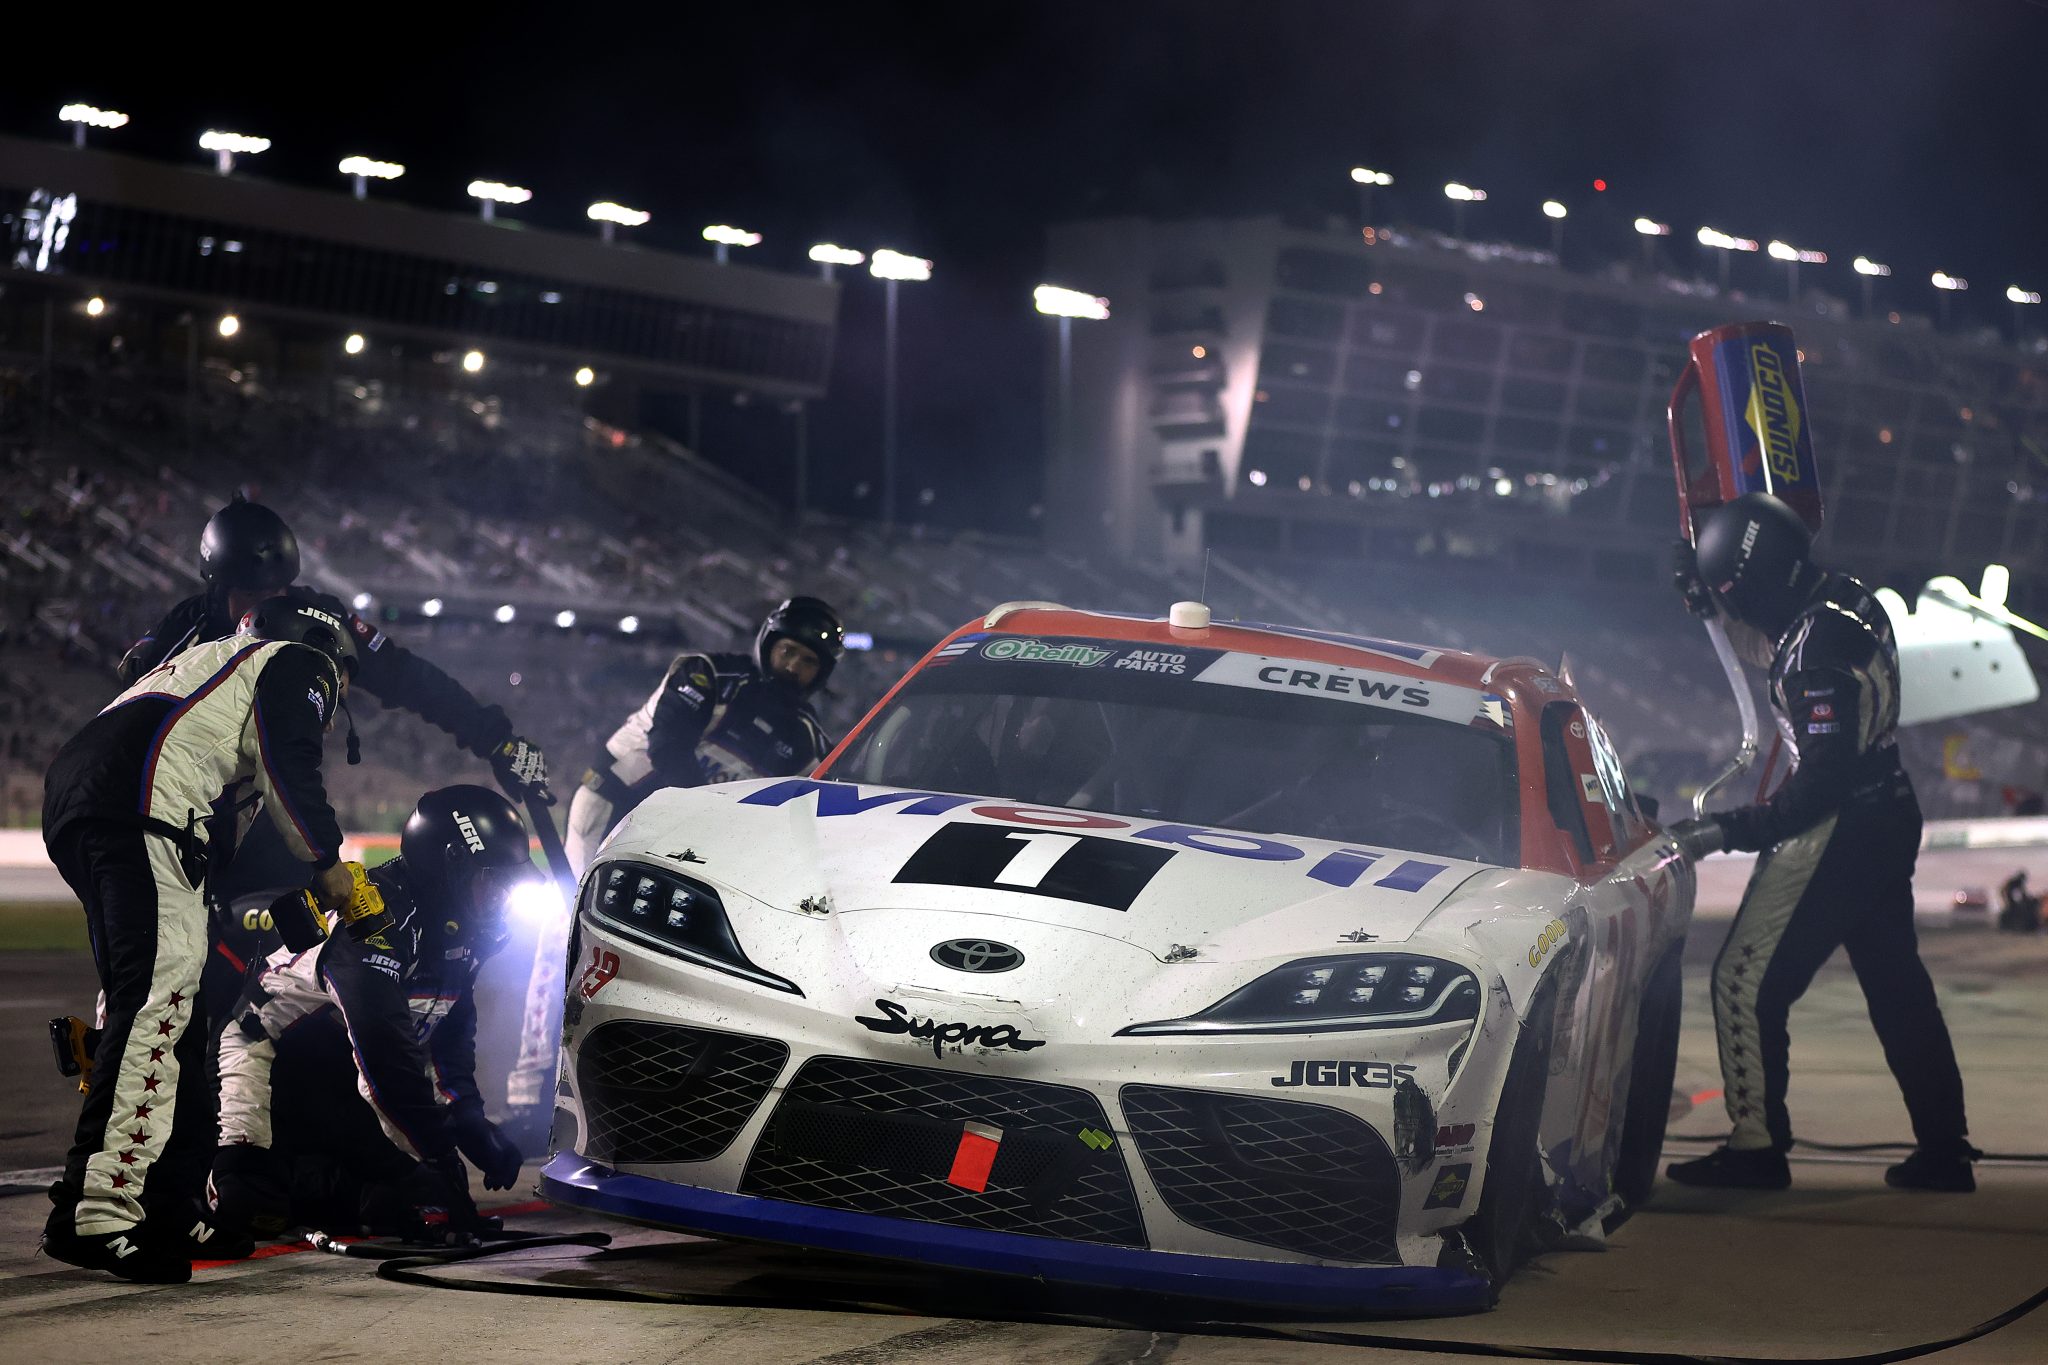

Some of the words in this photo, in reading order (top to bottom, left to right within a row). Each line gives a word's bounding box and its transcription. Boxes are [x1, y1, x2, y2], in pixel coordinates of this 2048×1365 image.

[1755, 345, 1798, 481] SUNOCO
[1744, 519, 1760, 559] JGR
[297, 607, 340, 631] JGR
[983, 640, 1110, 667] O'Reilly
[1113, 658, 1186, 675] PARTS
[1125, 650, 1186, 665] AUTO
[1258, 666, 1430, 708] CREWS
[452, 810, 486, 855] JGR
[736, 779, 1451, 893] Mobil
[993, 832, 1084, 888] 1
[855, 999, 1046, 1060] Supra
